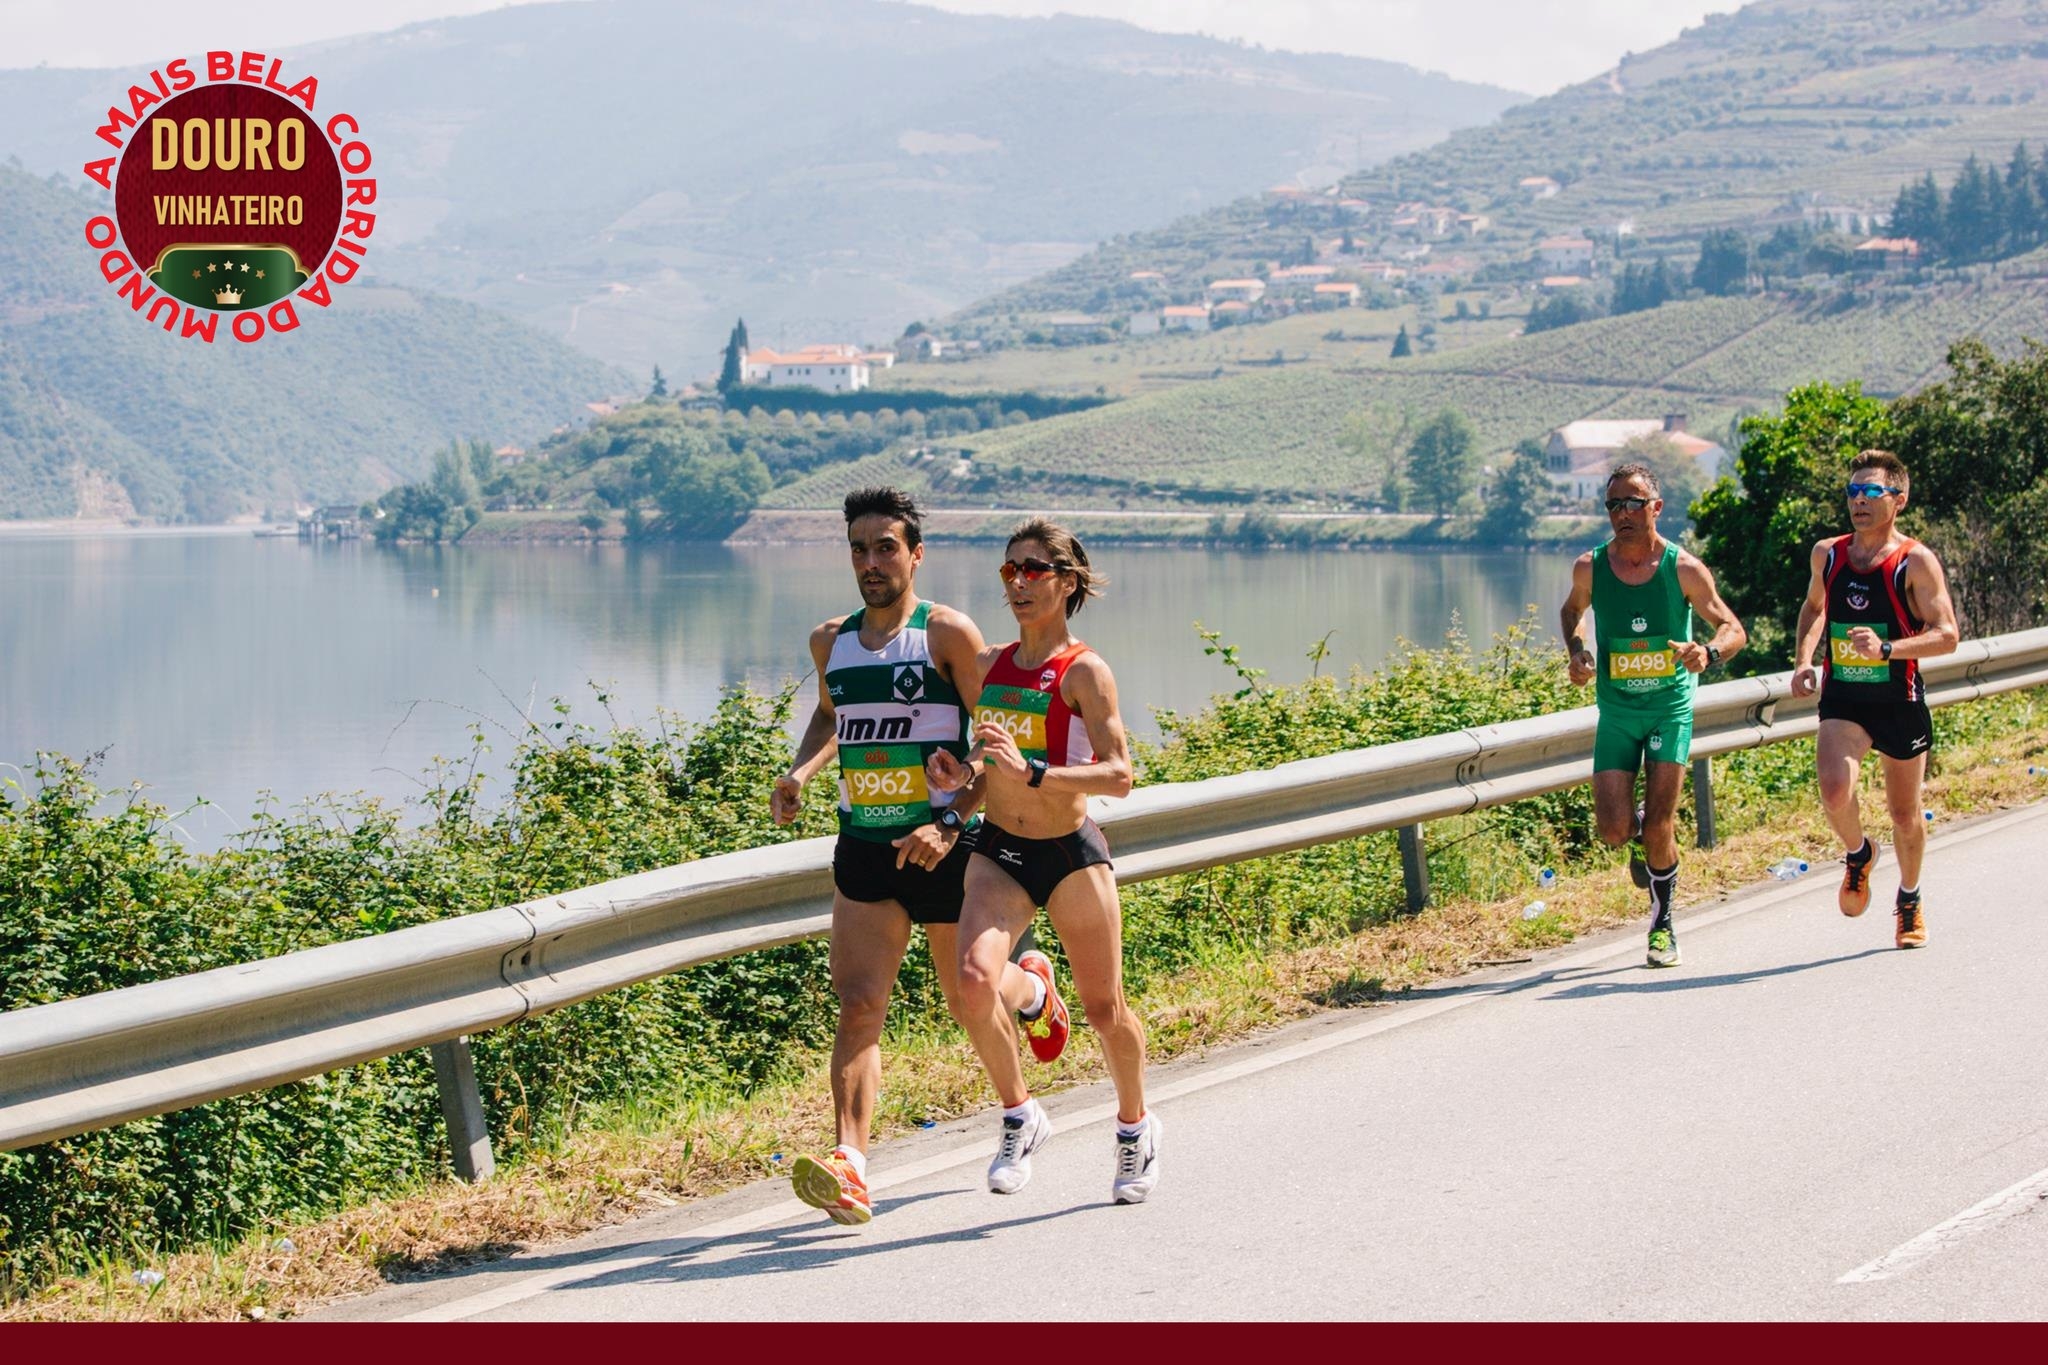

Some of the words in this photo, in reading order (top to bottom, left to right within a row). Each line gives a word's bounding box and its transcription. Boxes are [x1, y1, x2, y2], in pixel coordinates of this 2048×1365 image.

[1617, 653, 1666, 673] 9498
[1842, 666, 1873, 675] DOURO
[1626, 678, 1660, 688] DOURO
[853, 769, 914, 797] 9962
[863, 805, 906, 817] DOURO
